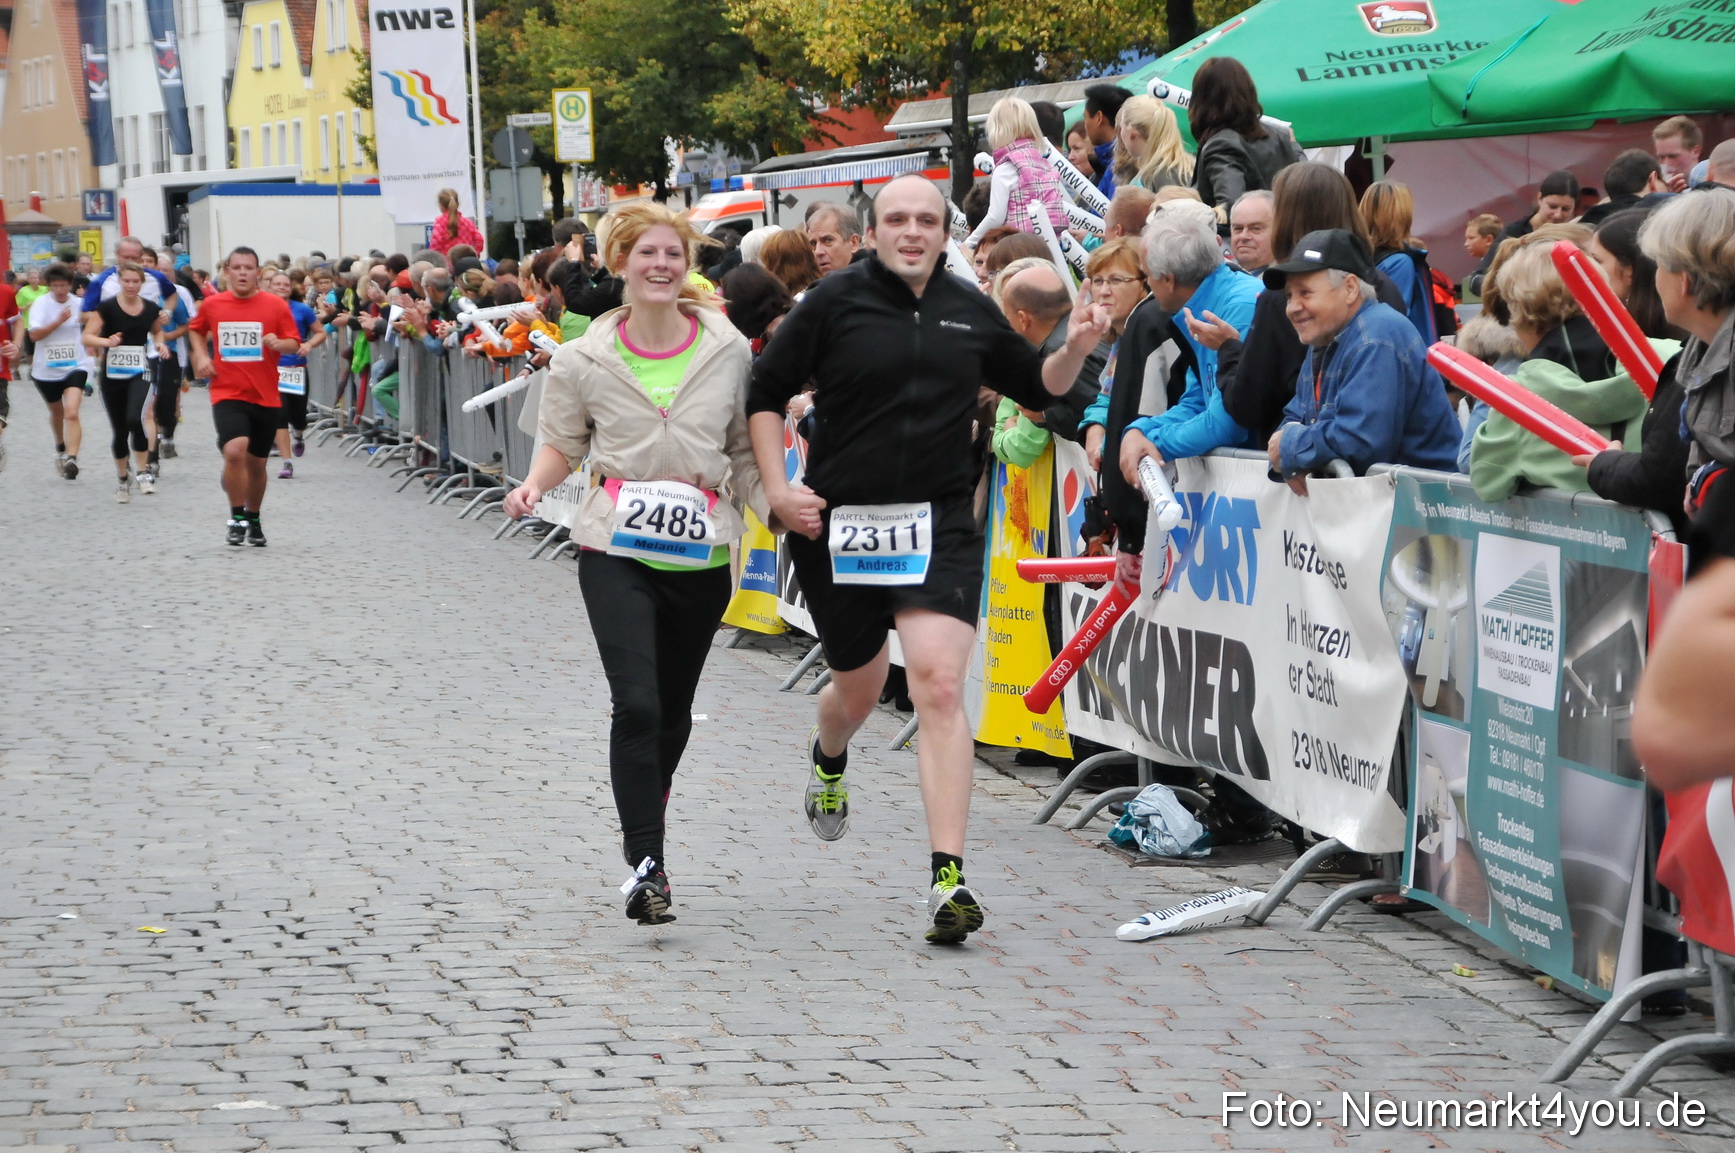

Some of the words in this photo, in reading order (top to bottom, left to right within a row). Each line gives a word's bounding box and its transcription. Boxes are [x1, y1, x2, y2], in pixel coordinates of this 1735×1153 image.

[1325, 39, 1493, 63] Neumarkte
[85, 241, 97, 256] D
[946, 320, 971, 329] Columbia
[222, 331, 257, 346] 2178
[47, 347, 75, 360] 2650
[111, 353, 140, 366] 2299
[279, 371, 301, 384] 219
[622, 487, 654, 497] PARTL
[657, 488, 700, 504] Neumarkt
[624, 498, 707, 541] 2485
[833, 513, 865, 521] PARTL
[867, 512, 913, 521] Neumarkt
[634, 538, 686, 554] Melanie
[841, 521, 918, 552] 2311
[1603, 530, 1628, 552] Bayern
[857, 559, 908, 572] Andreas
[1093, 601, 1118, 630] Audi
[1073, 628, 1097, 654] BKK
[1301, 608, 1351, 660] Herzen
[1481, 613, 1512, 642] MATHI
[1513, 621, 1555, 653] HOFFER
[1498, 666, 1532, 687] FASSADENBAU
[1518, 655, 1553, 675] TROCKENBAU
[1306, 659, 1339, 707] Stadt
[1487, 718, 1506, 741] 92318
[1505, 723, 1532, 752] Neumarkt
[1291, 728, 1328, 776] 2318
[1497, 812, 1535, 843] Trockenbau
[1477, 831, 1555, 879] Fassadenverkleidungen
[1516, 896, 1563, 931] Sanierungen
